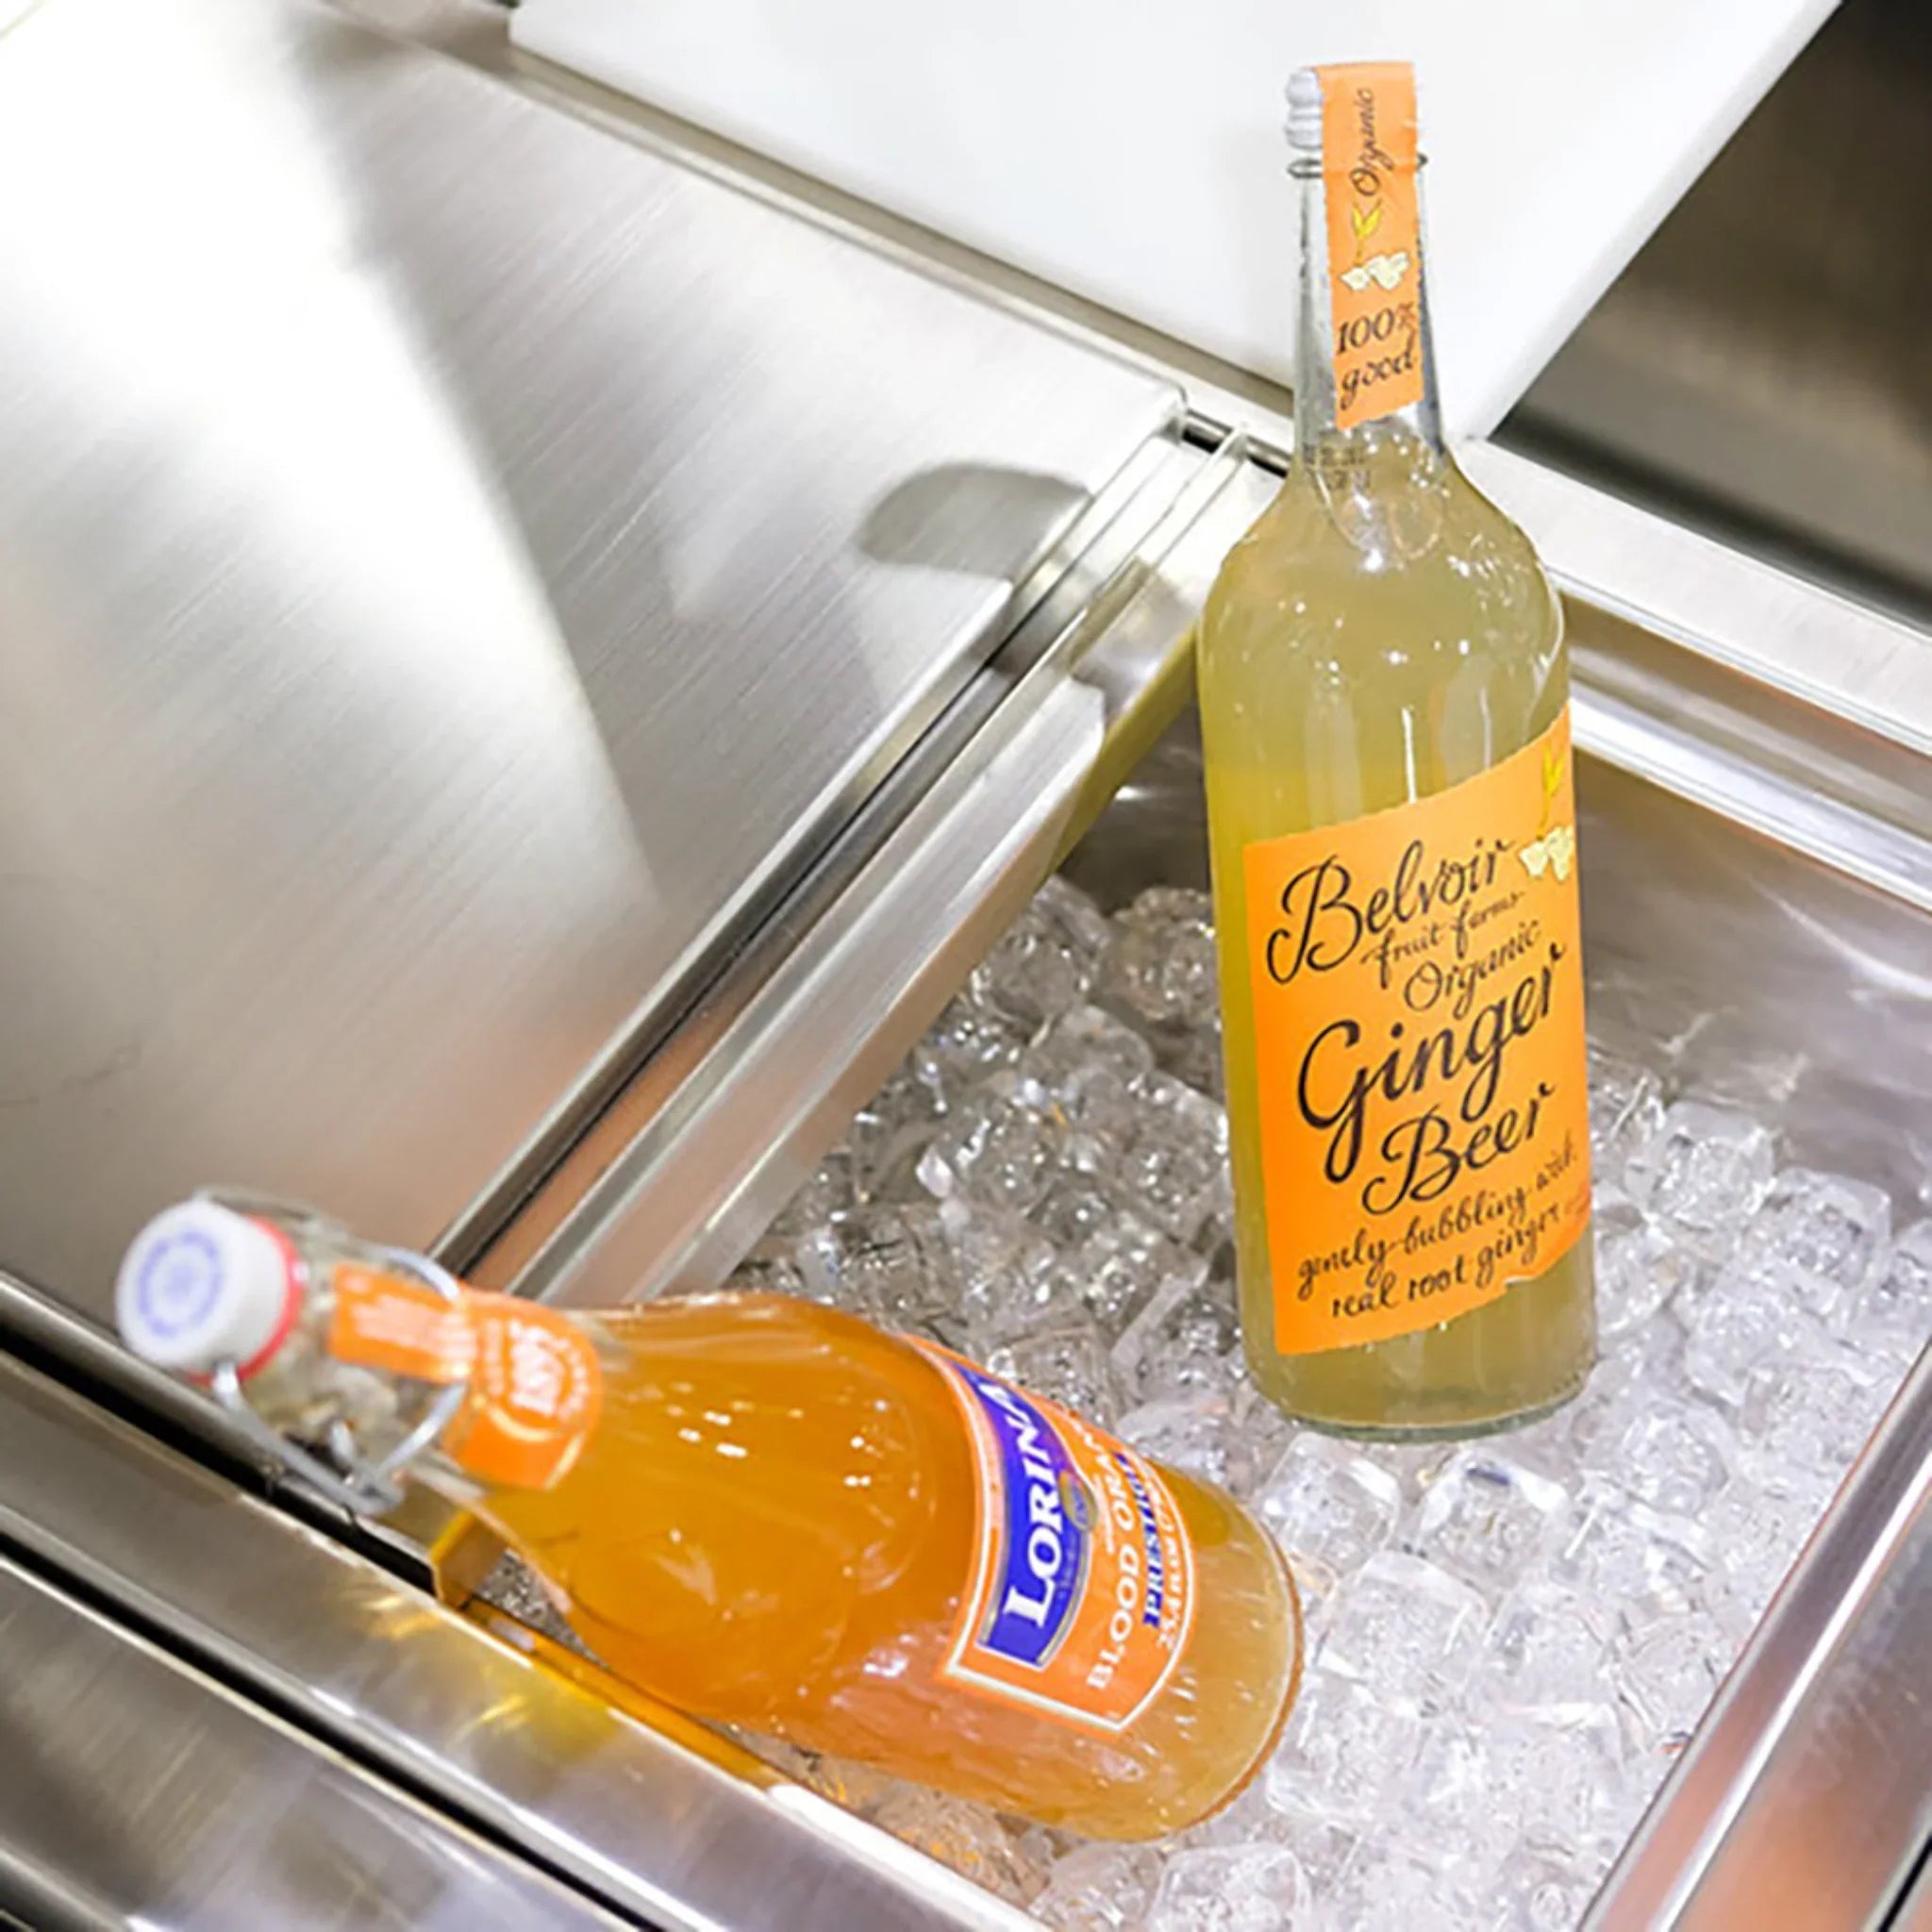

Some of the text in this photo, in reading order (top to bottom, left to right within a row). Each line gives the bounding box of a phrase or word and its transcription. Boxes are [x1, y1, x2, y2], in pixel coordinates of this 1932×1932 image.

[1349, 88, 1396, 196] Organic
[1340, 329, 1416, 410] good
[1266, 839, 1515, 985] Belvoir
[1360, 924, 1446, 990] fruit
[1404, 919, 1541, 1021] Organic
[1297, 941, 1566, 1184] Ginger
[1361, 1082, 1555, 1216] Beer
[1332, 1271, 1398, 1319] real
[1408, 1256, 1467, 1302] root
[978, 1381, 1064, 1628] LORINA
[1086, 1541, 1141, 1690] BLOOD
